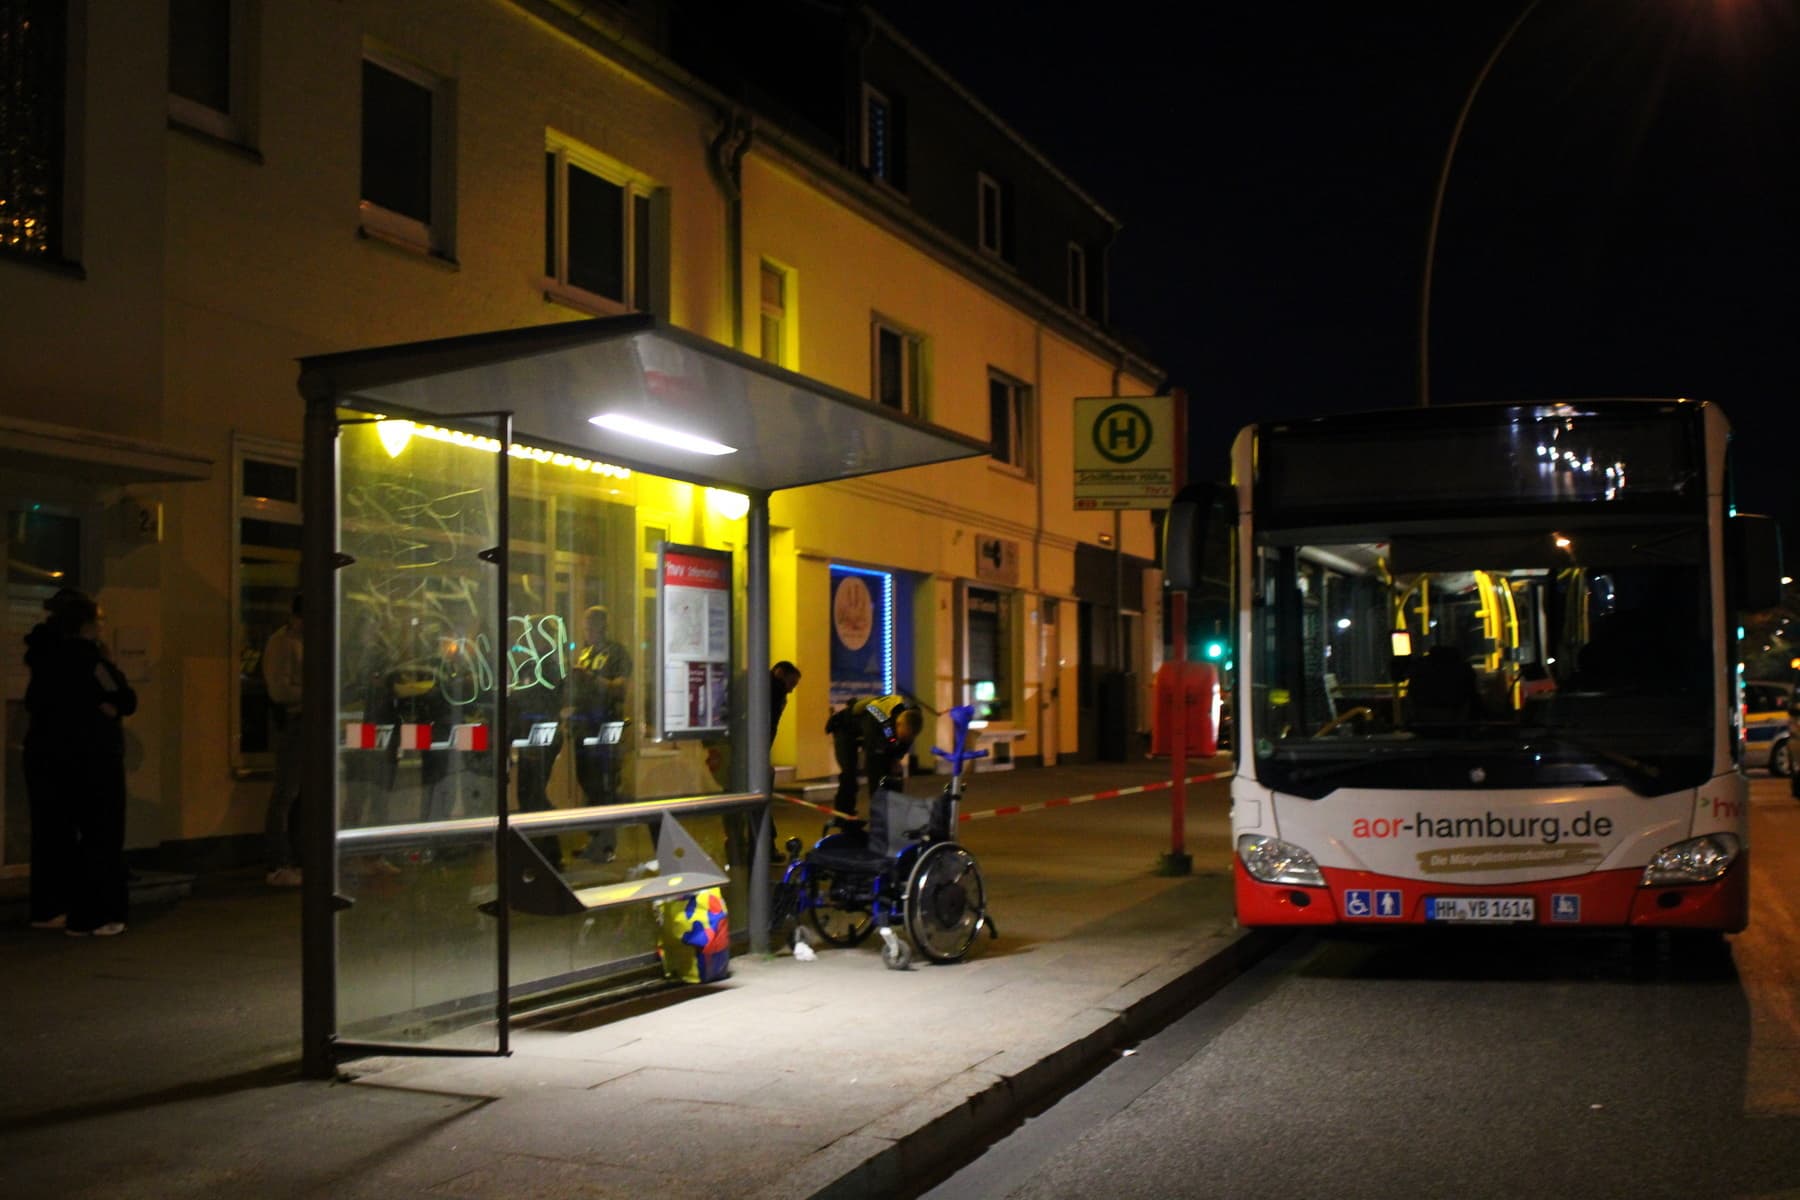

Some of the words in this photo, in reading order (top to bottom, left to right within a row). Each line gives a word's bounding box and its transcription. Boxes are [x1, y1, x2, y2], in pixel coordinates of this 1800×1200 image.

[1352, 811, 1612, 843] aor-hamburg.de
[1436, 901, 1456, 917] HH
[1468, 901, 1488, 917] YB
[1492, 901, 1531, 918] 1614
